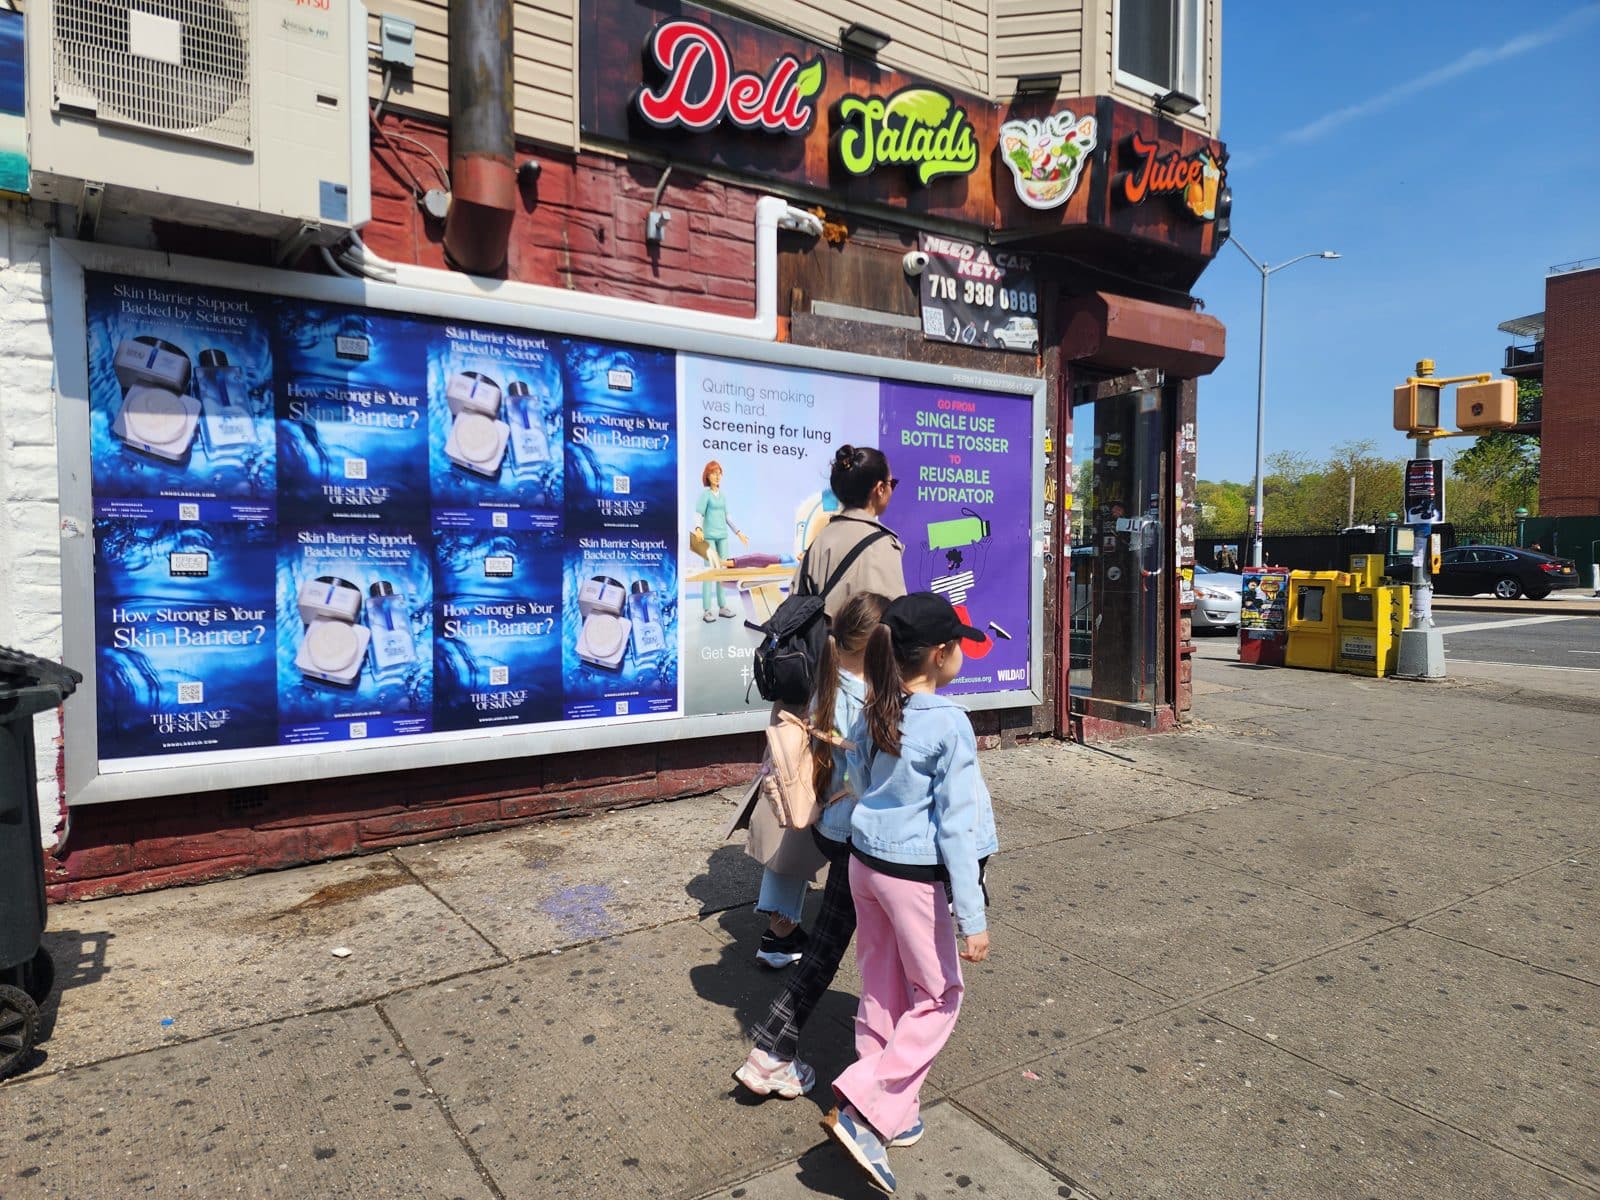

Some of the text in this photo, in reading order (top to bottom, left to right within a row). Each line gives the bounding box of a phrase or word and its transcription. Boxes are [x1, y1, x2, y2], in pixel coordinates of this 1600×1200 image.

[638, 20, 812, 129] Deli
[840, 96, 976, 185] Salads
[1125, 134, 1204, 203] Juice
[924, 235, 1032, 272] NEED A CAR
[113, 283, 254, 314] Skin Barrier Support.
[928, 273, 957, 301] 718
[999, 287, 1038, 314] 0888
[120, 300, 169, 317] Backed
[170, 306, 192, 322] by
[195, 308, 249, 327] Science
[446, 326, 549, 351] Skin Barrier Support.
[451, 341, 489, 355] Backed
[490, 344, 503, 358] by
[505, 348, 545, 362] Science
[287, 382, 420, 408] How Strong is Your
[702, 377, 815, 408] Quitting smoking
[288, 401, 335, 422] Skin
[702, 400, 767, 417] was hard.
[937, 399, 976, 412] GO FROM
[571, 410, 670, 432] How Strong is Your
[702, 416, 832, 444] Screening for lung
[916, 410, 996, 433] SINGLE USE
[572, 426, 608, 445] Skin
[901, 429, 1009, 454] BOTTLE TOSSER
[702, 438, 809, 459] cancer is easy.
[949, 454, 962, 465] TO
[919, 465, 991, 485] REUSABLE
[321, 484, 390, 498] THE SCIENCE
[328, 495, 344, 505] OF
[344, 495, 372, 506] SKIN
[917, 485, 995, 504] HYDRATOR
[596, 499, 647, 510] THE SCIENCE
[601, 507, 613, 516] OF
[613, 507, 633, 517] SKIN
[297, 531, 417, 548] Skin Barrier Support.
[578, 538, 668, 552] Skin Barrier Support.
[304, 545, 411, 560] Backed by Science
[583, 550, 663, 562] Backed by Science
[112, 606, 266, 626] How Strong is Your
[443, 602, 555, 619] How Strong is Your
[113, 626, 167, 649] Skin
[443, 620, 483, 639] Skin
[701, 646, 725, 660] Get
[470, 690, 529, 703] THE SCIENCE
[476, 702, 489, 711] OF
[489, 700, 512, 710] SKIN
[150, 709, 231, 725] THE SCIENCE
[158, 723, 177, 735] OF
[177, 720, 208, 733] SKIN
